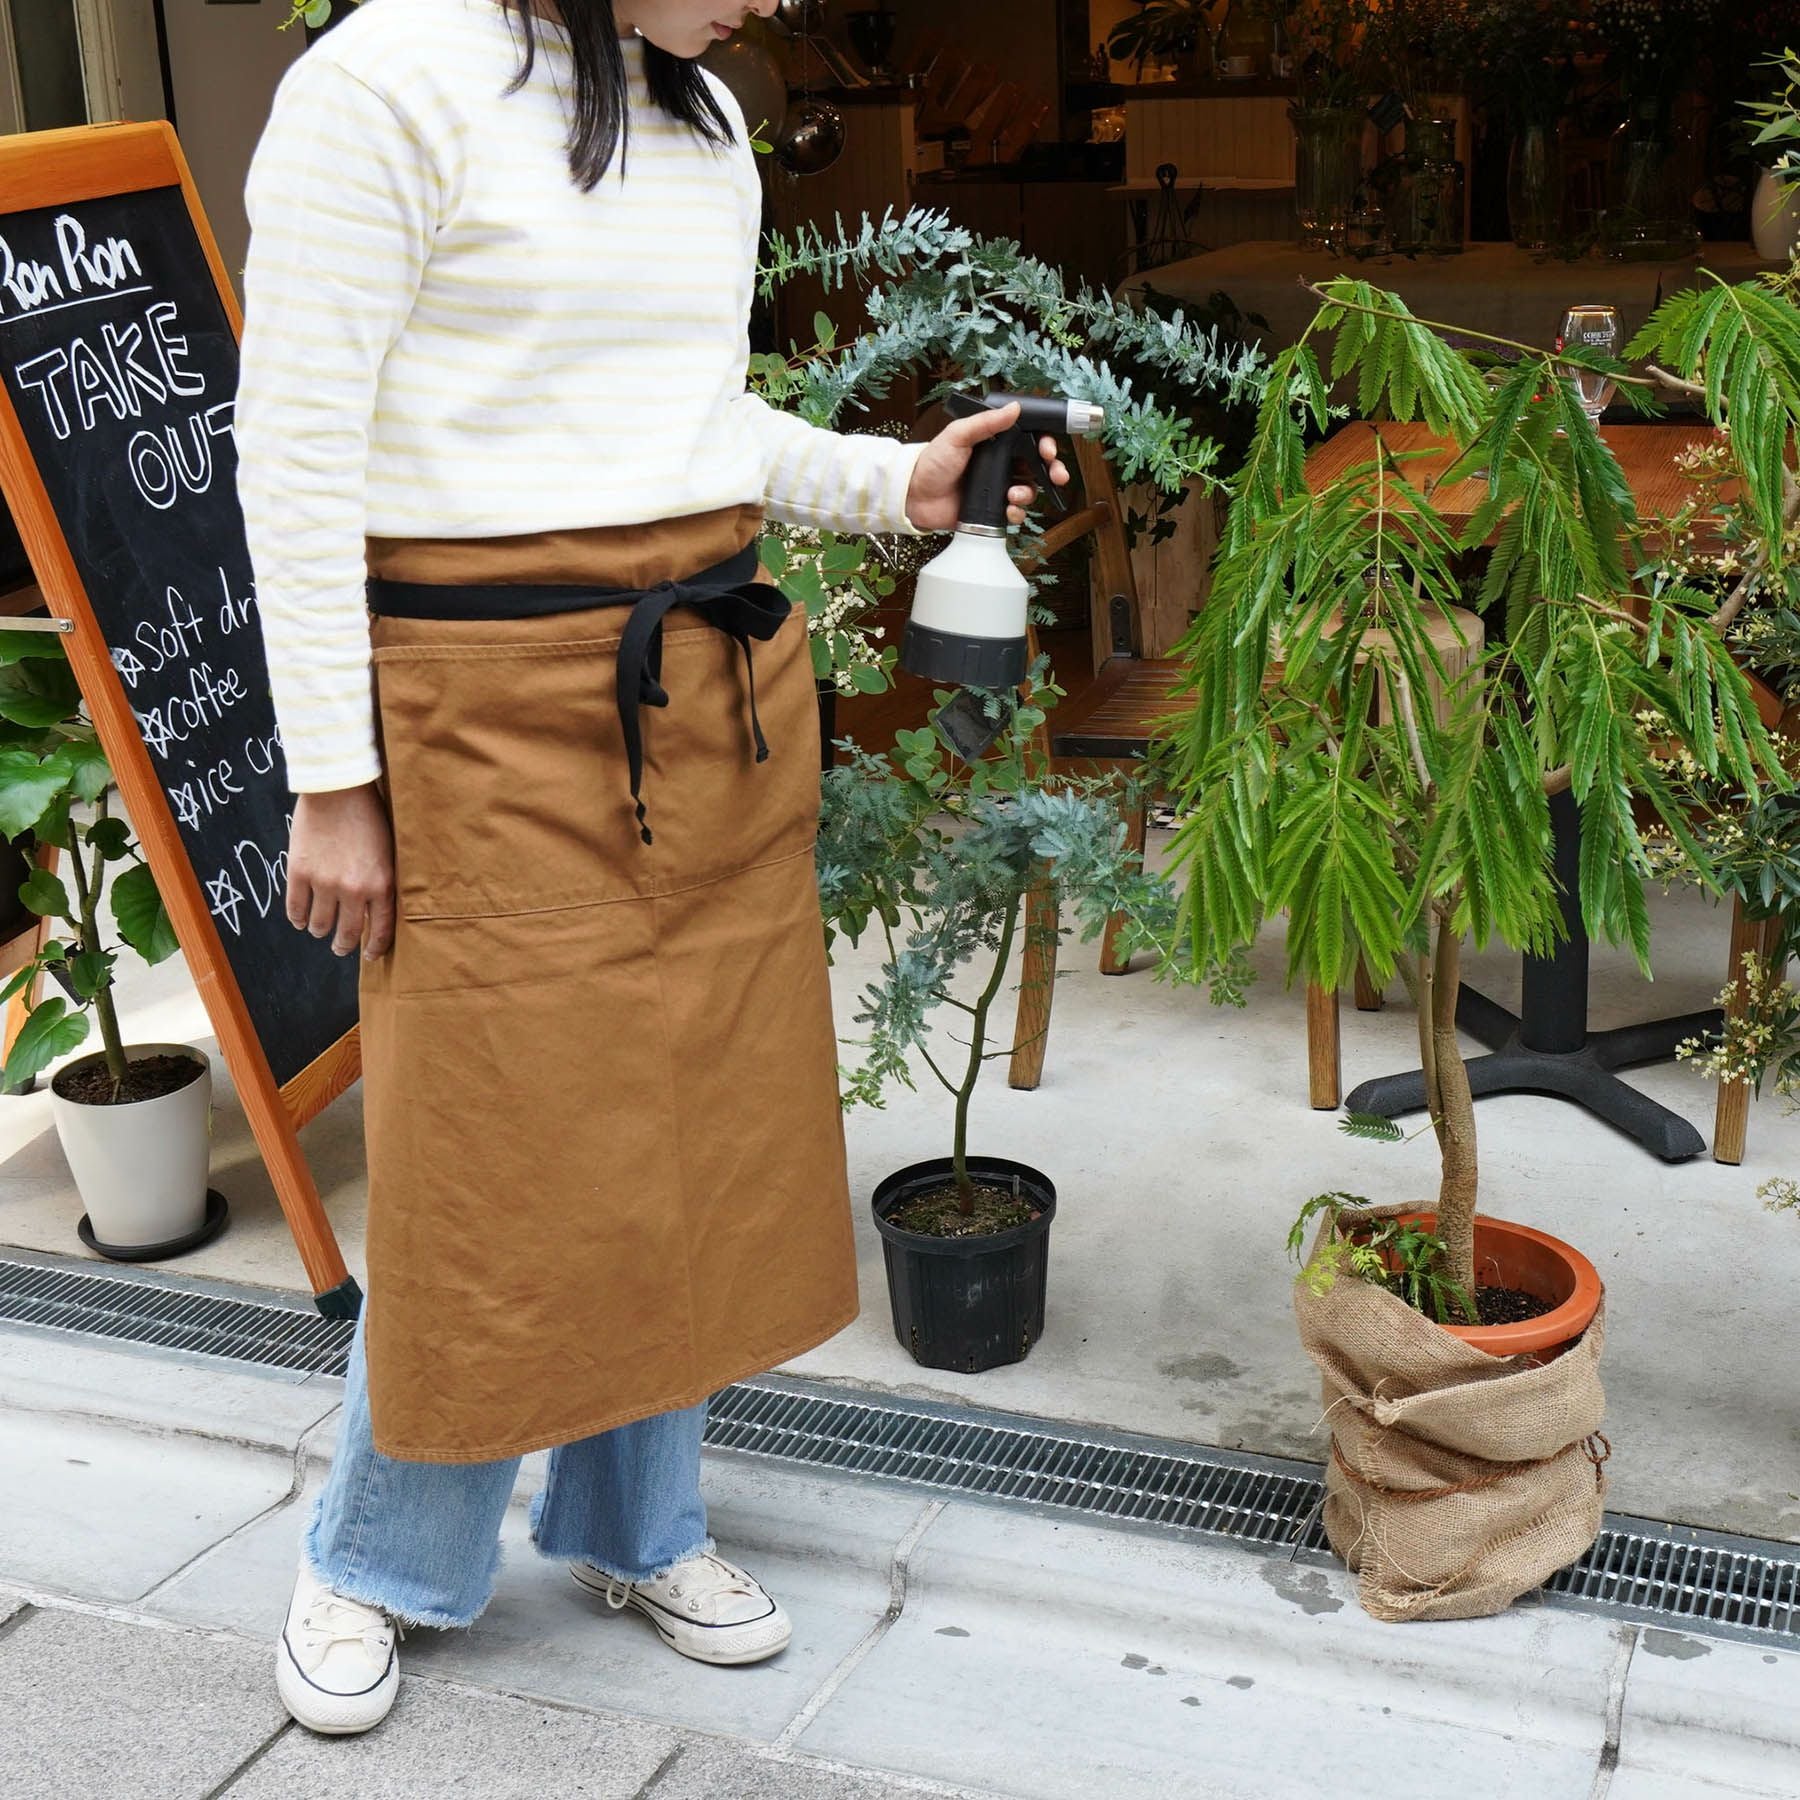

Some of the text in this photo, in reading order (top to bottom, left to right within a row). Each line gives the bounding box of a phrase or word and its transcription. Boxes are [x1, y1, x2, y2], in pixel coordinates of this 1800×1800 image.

[53, 214, 142, 293] Ron
[15, 301, 206, 439] TAKE
[135, 585, 204, 673] Soft
[187, 759, 245, 815] ice
